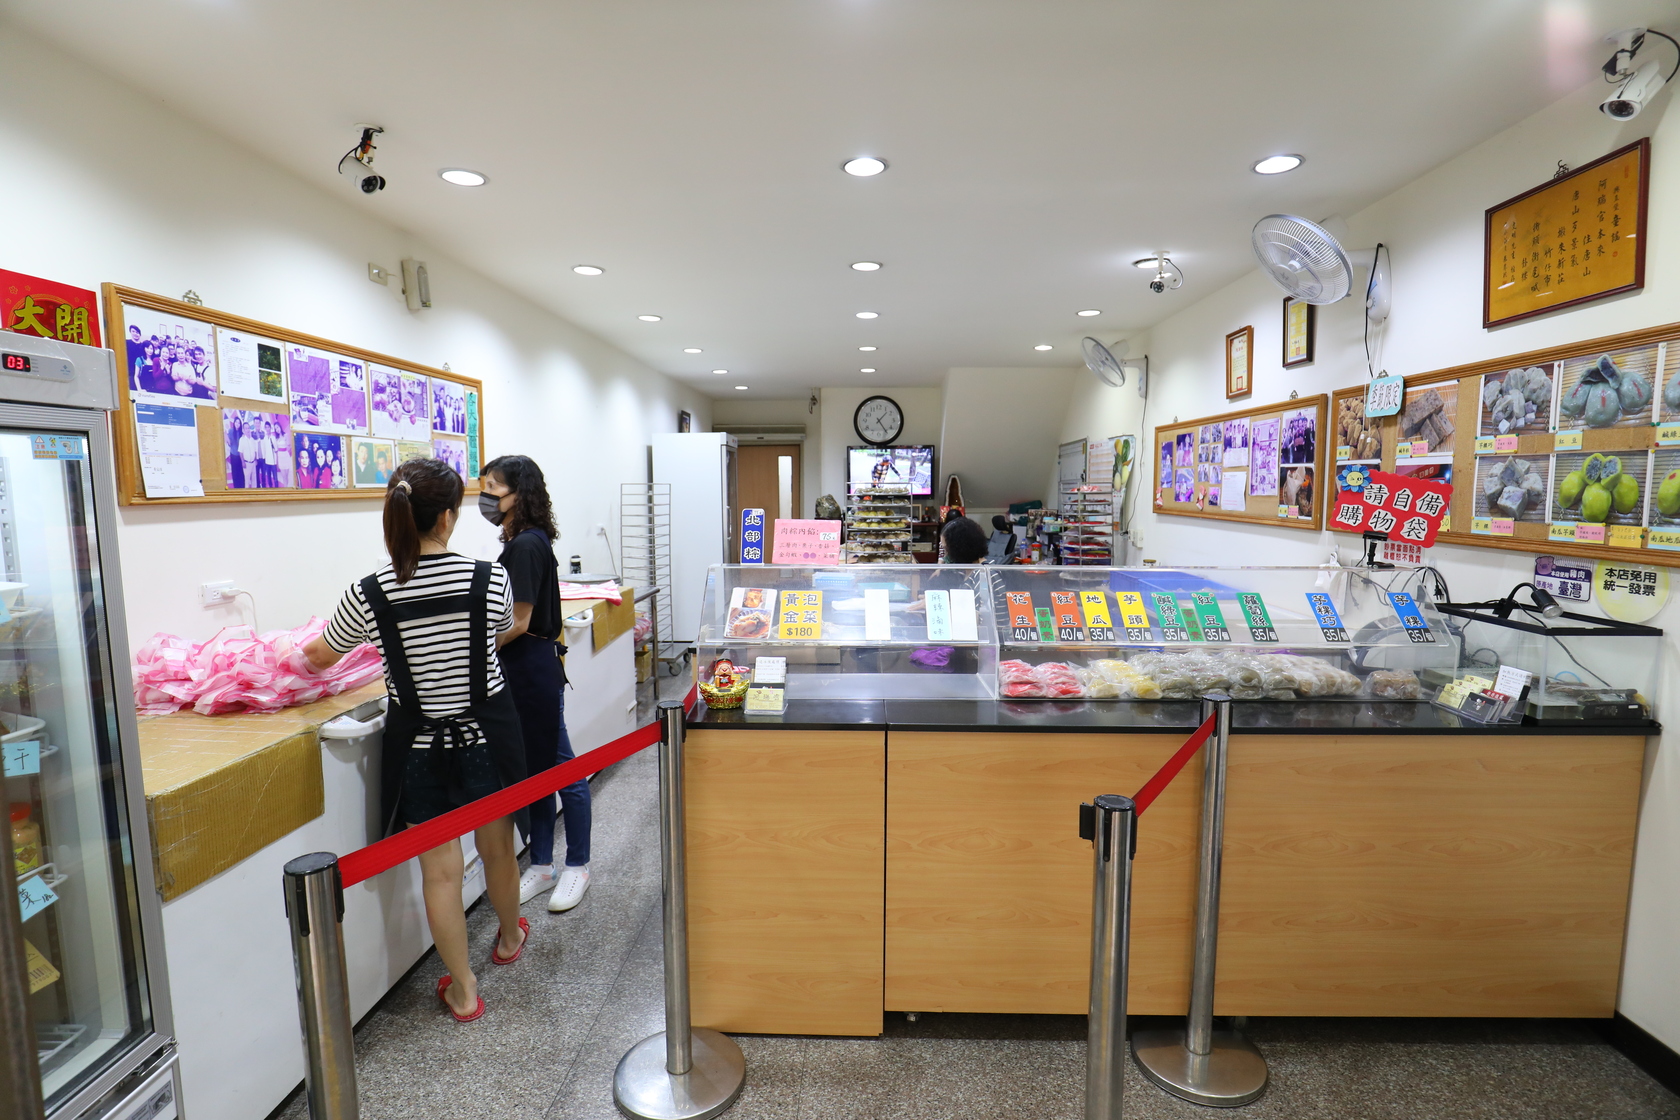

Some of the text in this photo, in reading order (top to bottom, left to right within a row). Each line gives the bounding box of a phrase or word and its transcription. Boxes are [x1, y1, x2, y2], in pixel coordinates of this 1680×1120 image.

[7, 355, 24, 369] 03
[1364, 485, 1443, 515] 請自備
[744, 515, 761, 560] 北部粽
[1338, 505, 1426, 539] 購物袋
[1558, 581, 1582, 599] 臺灣
[1603, 580, 1656, 597] 統一發票
[1605, 567, 1657, 584] 本店免用
[1012, 594, 1032, 625] 花生
[1056, 594, 1077, 625] 紅豆
[1086, 594, 1108, 625] 地瓜
[1123, 594, 1144, 625] 芋頭
[1156, 595, 1180, 626] 鹹綠豆
[1197, 595, 1221, 626] 紅豆
[1312, 595, 1337, 626] 芋粿巧
[1394, 595, 1423, 626] 芋粿
[786, 627, 813, 636] $180
